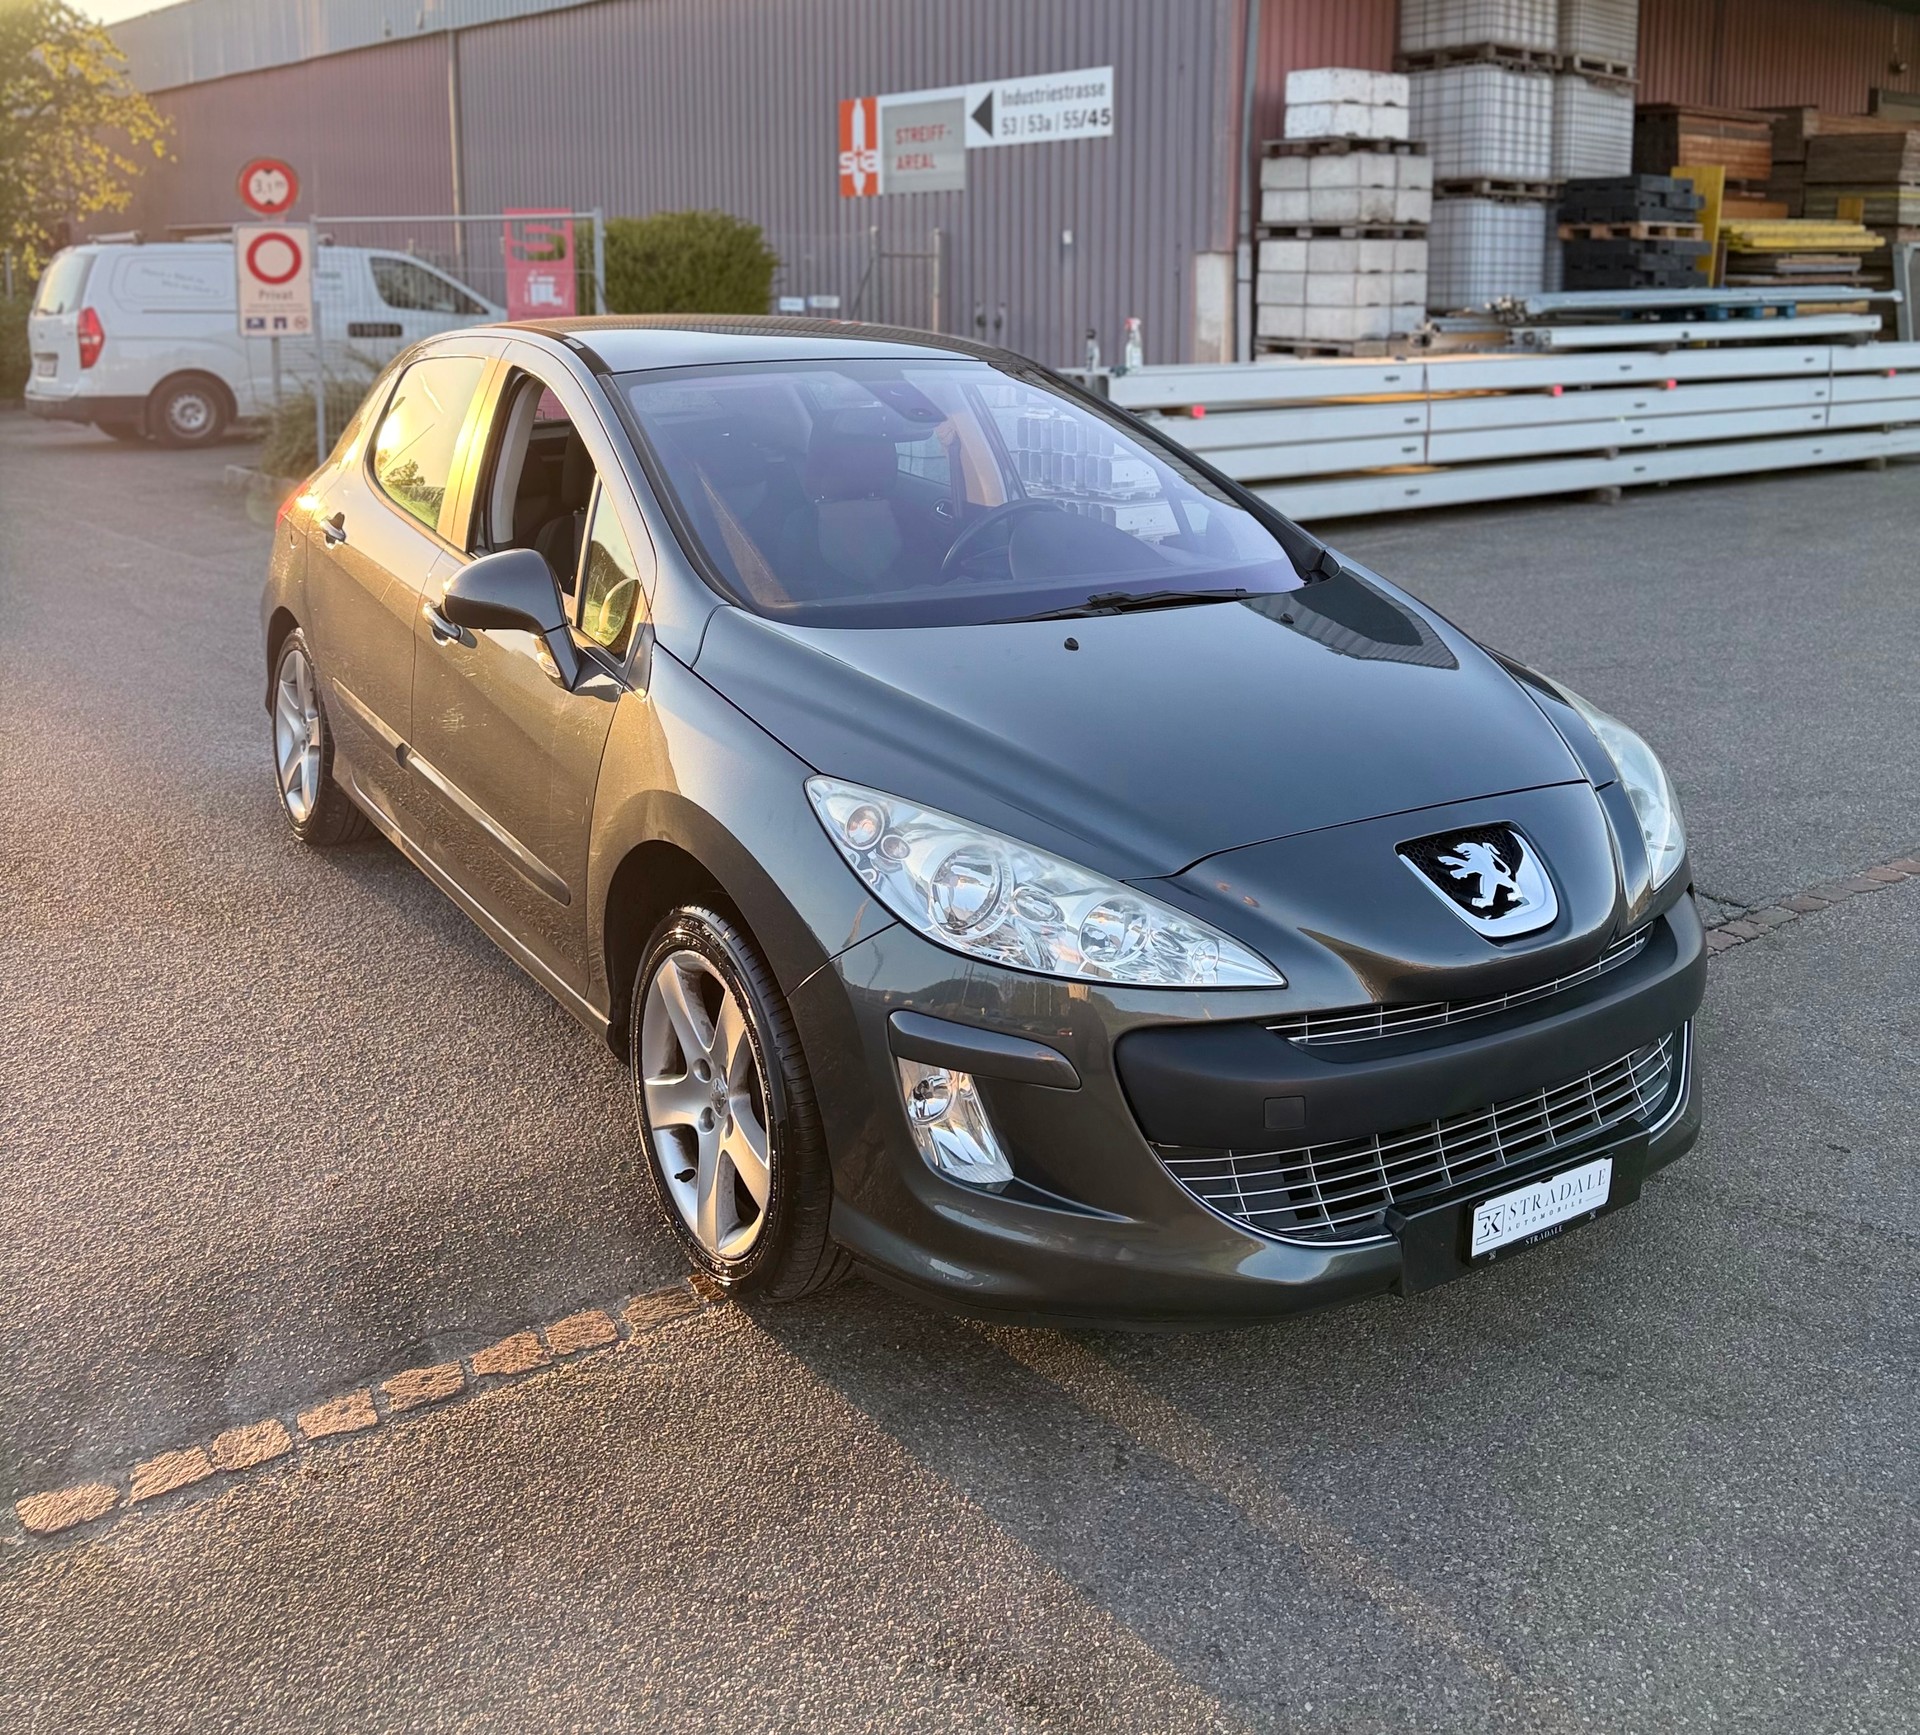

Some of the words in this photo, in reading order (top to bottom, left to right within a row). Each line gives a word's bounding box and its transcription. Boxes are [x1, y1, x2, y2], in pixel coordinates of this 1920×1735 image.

[1001, 82, 1106, 107] Industriestrasse
[1002, 116, 1017, 136] 53
[1027, 113, 1052, 134] 53a
[896, 153, 936, 170] AREAL
[258, 289, 293, 300] Privat
[1508, 1168, 1607, 1221] STRADALE
[1507, 1198, 1583, 1233] AUTOMOBILE
[1524, 1224, 1564, 1246] STRADALE
